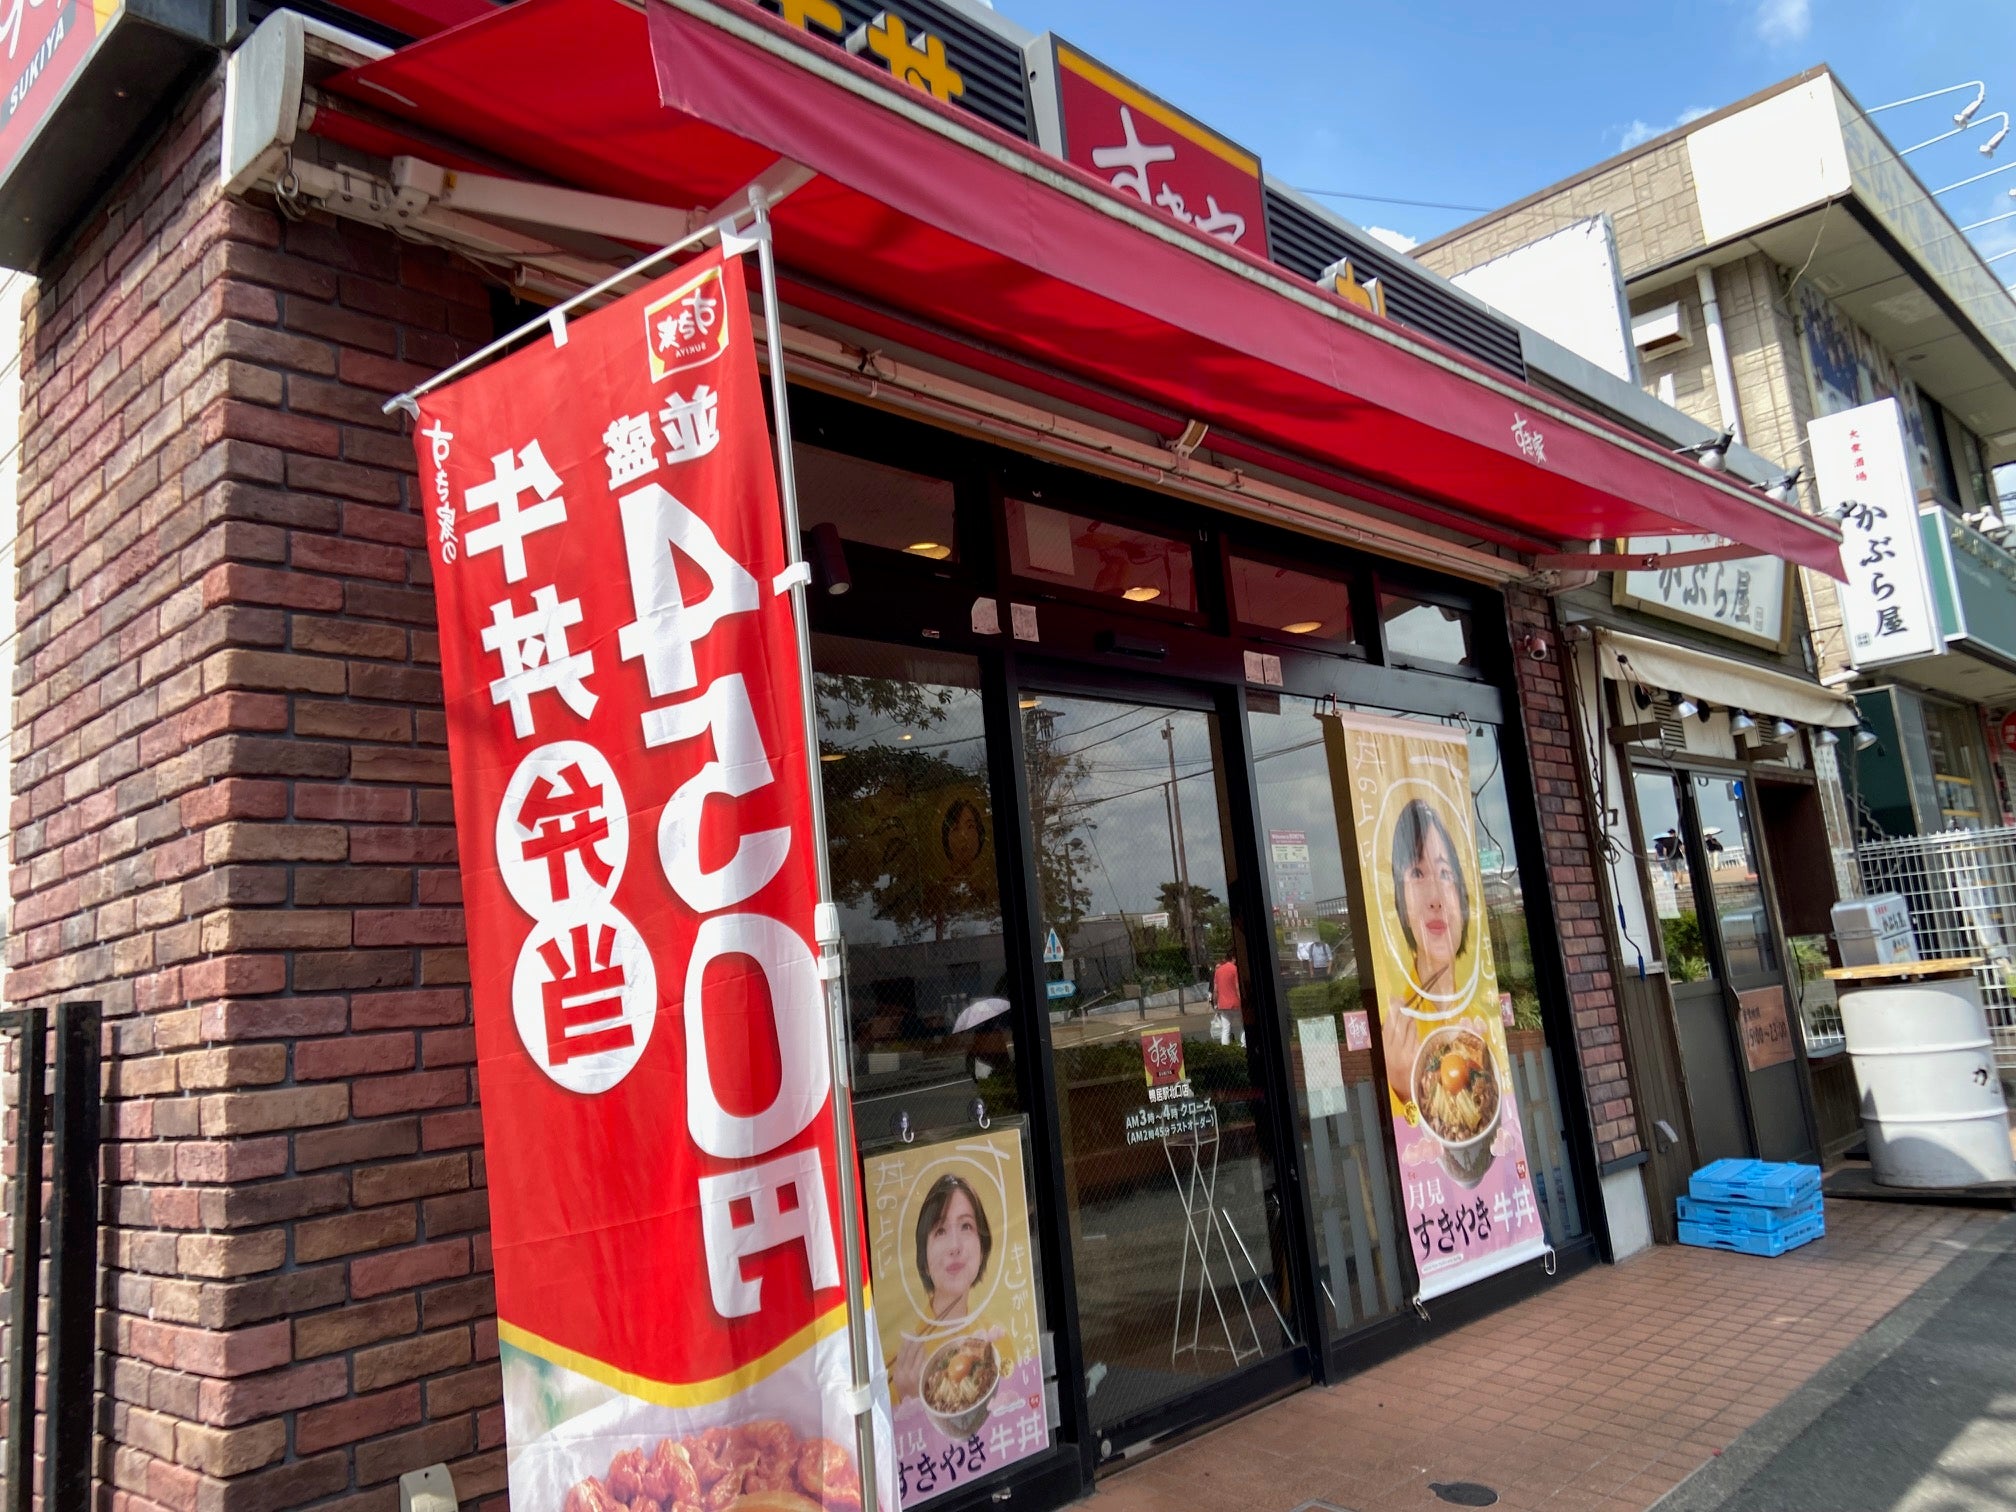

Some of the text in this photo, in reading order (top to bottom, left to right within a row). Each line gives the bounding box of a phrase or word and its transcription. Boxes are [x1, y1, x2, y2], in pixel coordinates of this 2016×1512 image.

[10, 16, 64, 115] SUKIYA
[1511, 411, 1546, 464] すき家
[1851, 502, 1909, 638] かぶら屋
